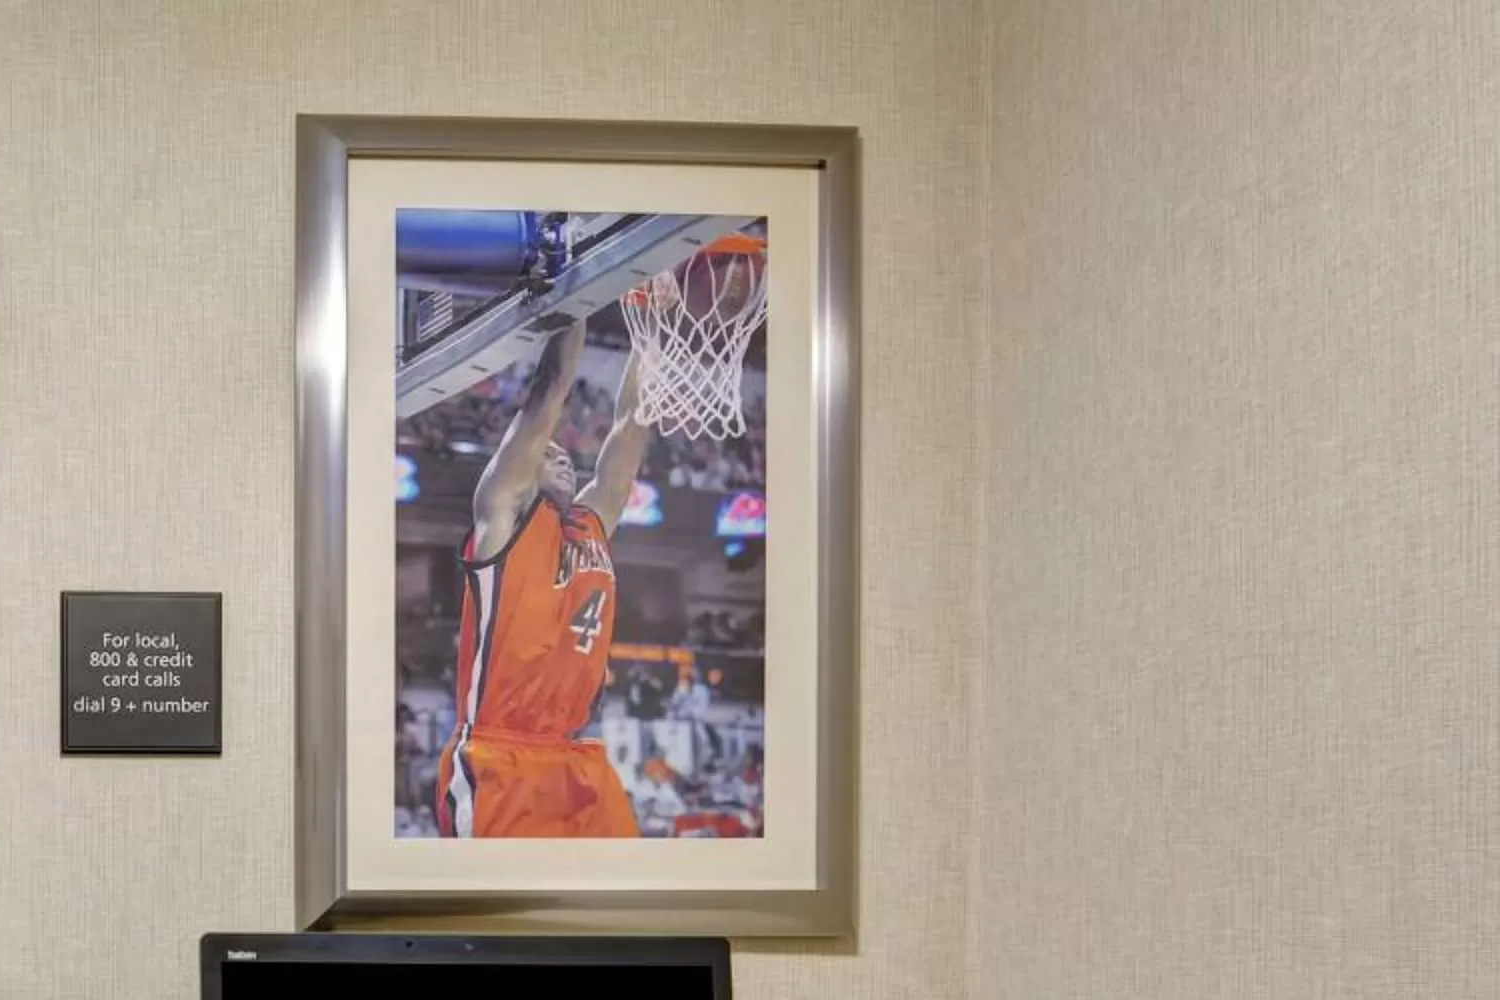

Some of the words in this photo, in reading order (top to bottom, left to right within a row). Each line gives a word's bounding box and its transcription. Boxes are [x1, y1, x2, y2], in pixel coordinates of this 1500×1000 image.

[568, 588, 607, 656] 4
[102, 632, 131, 648] For
[135, 631, 180, 650] local,
[89, 651, 121, 667] 800
[126, 651, 139, 667] &
[143, 651, 194, 667] credit
[102, 671, 140, 687] card
[144, 671, 182, 687] calls
[73, 696, 106, 713] dial
[111, 697, 122, 713] 9
[142, 697, 210, 713] number
